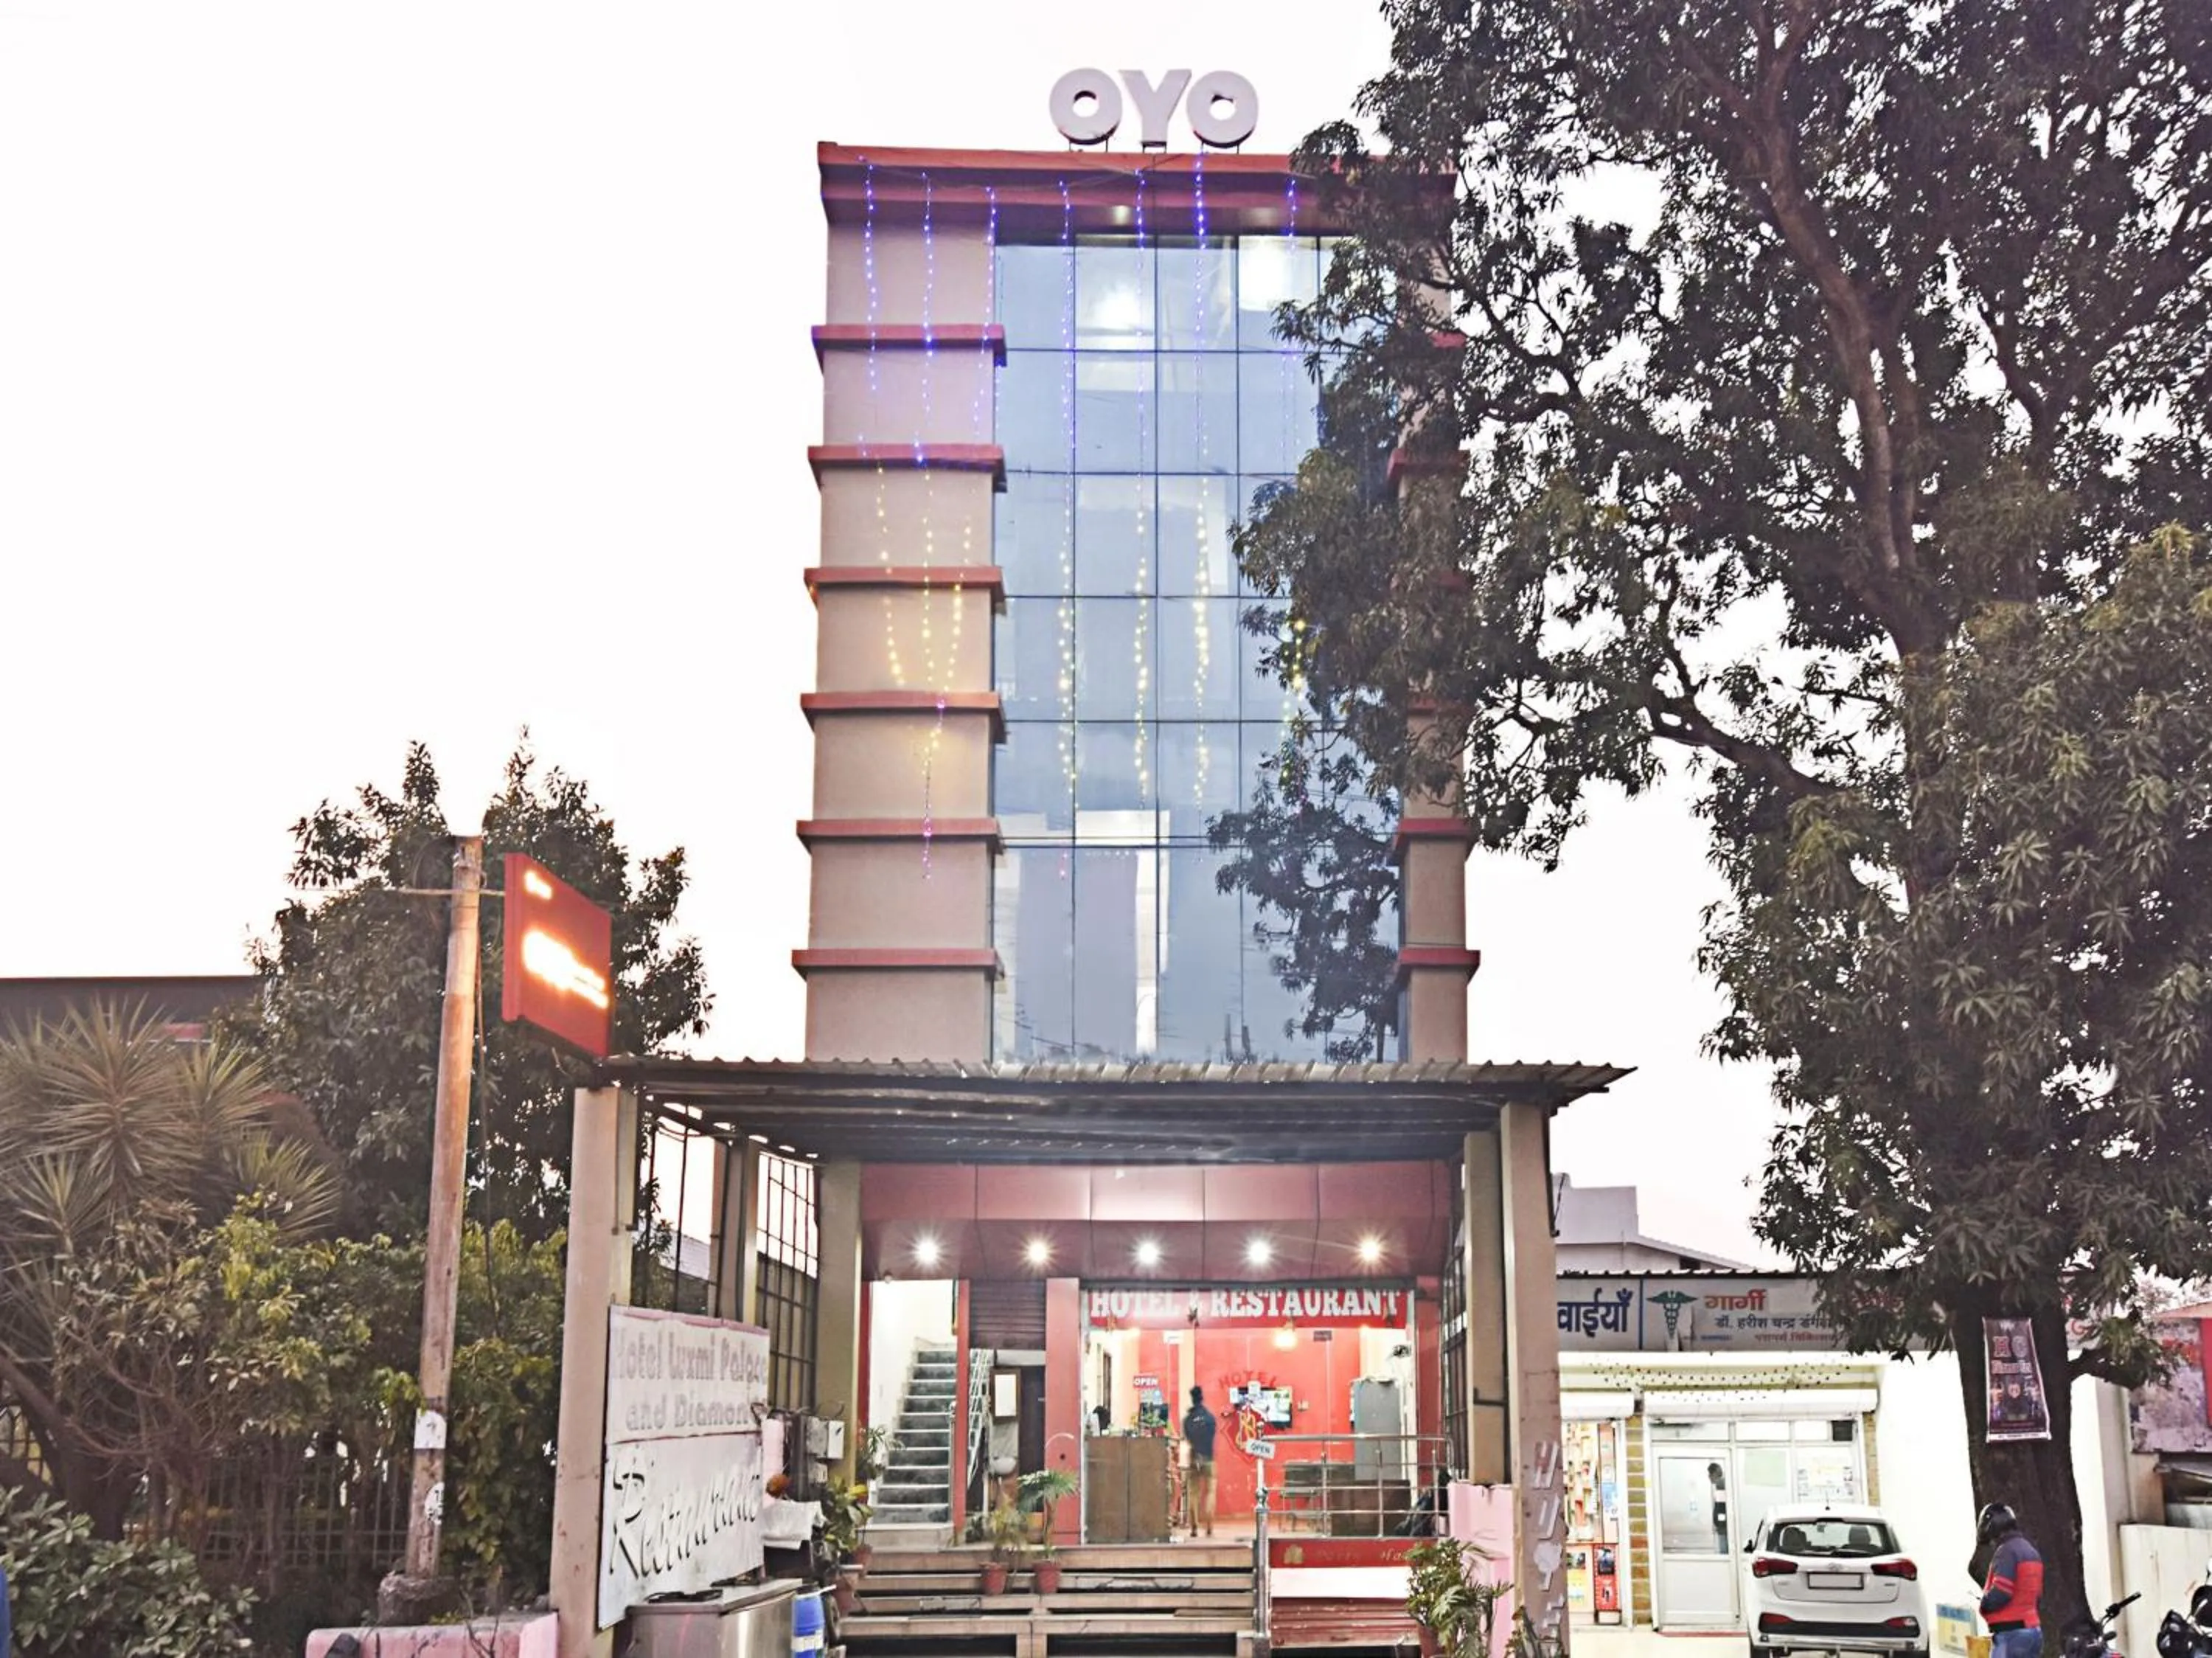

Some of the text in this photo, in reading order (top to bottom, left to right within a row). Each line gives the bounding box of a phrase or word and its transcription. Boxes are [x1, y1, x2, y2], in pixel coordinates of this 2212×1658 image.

[1049, 67, 1259, 148] OYO
[1091, 1290, 1182, 1317] HOTEL
[1211, 1289, 1399, 1317] RESTAURANT
[1704, 1288, 1767, 1311] गार्गी
[1135, 1378, 1158, 1387] OPEN
[1219, 1370, 1276, 1389] HOTEL
[674, 1392, 767, 1428] Diamon
[1251, 1443, 1270, 1454] OPEN
